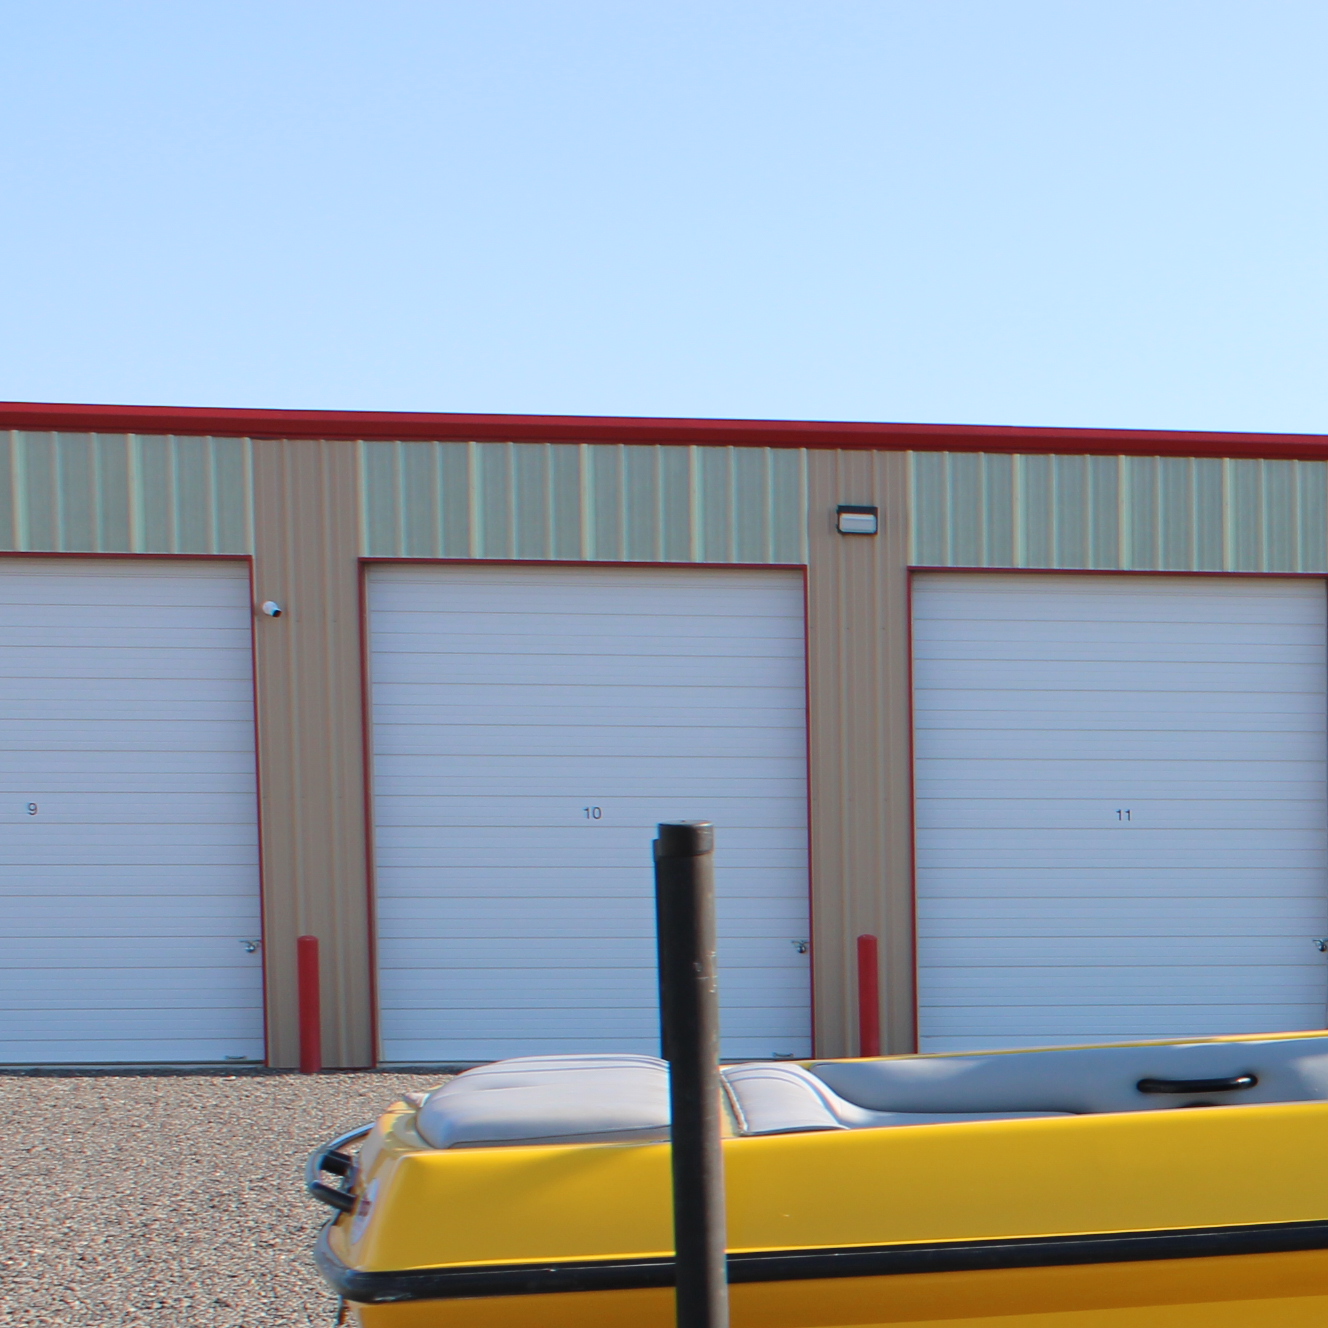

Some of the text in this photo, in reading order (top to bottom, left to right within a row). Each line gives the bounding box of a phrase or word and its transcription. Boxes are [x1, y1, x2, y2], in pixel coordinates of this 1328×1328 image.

[28, 802, 38, 816] 9
[583, 806, 602, 820] 10
[1115, 809, 1131, 821] 11
